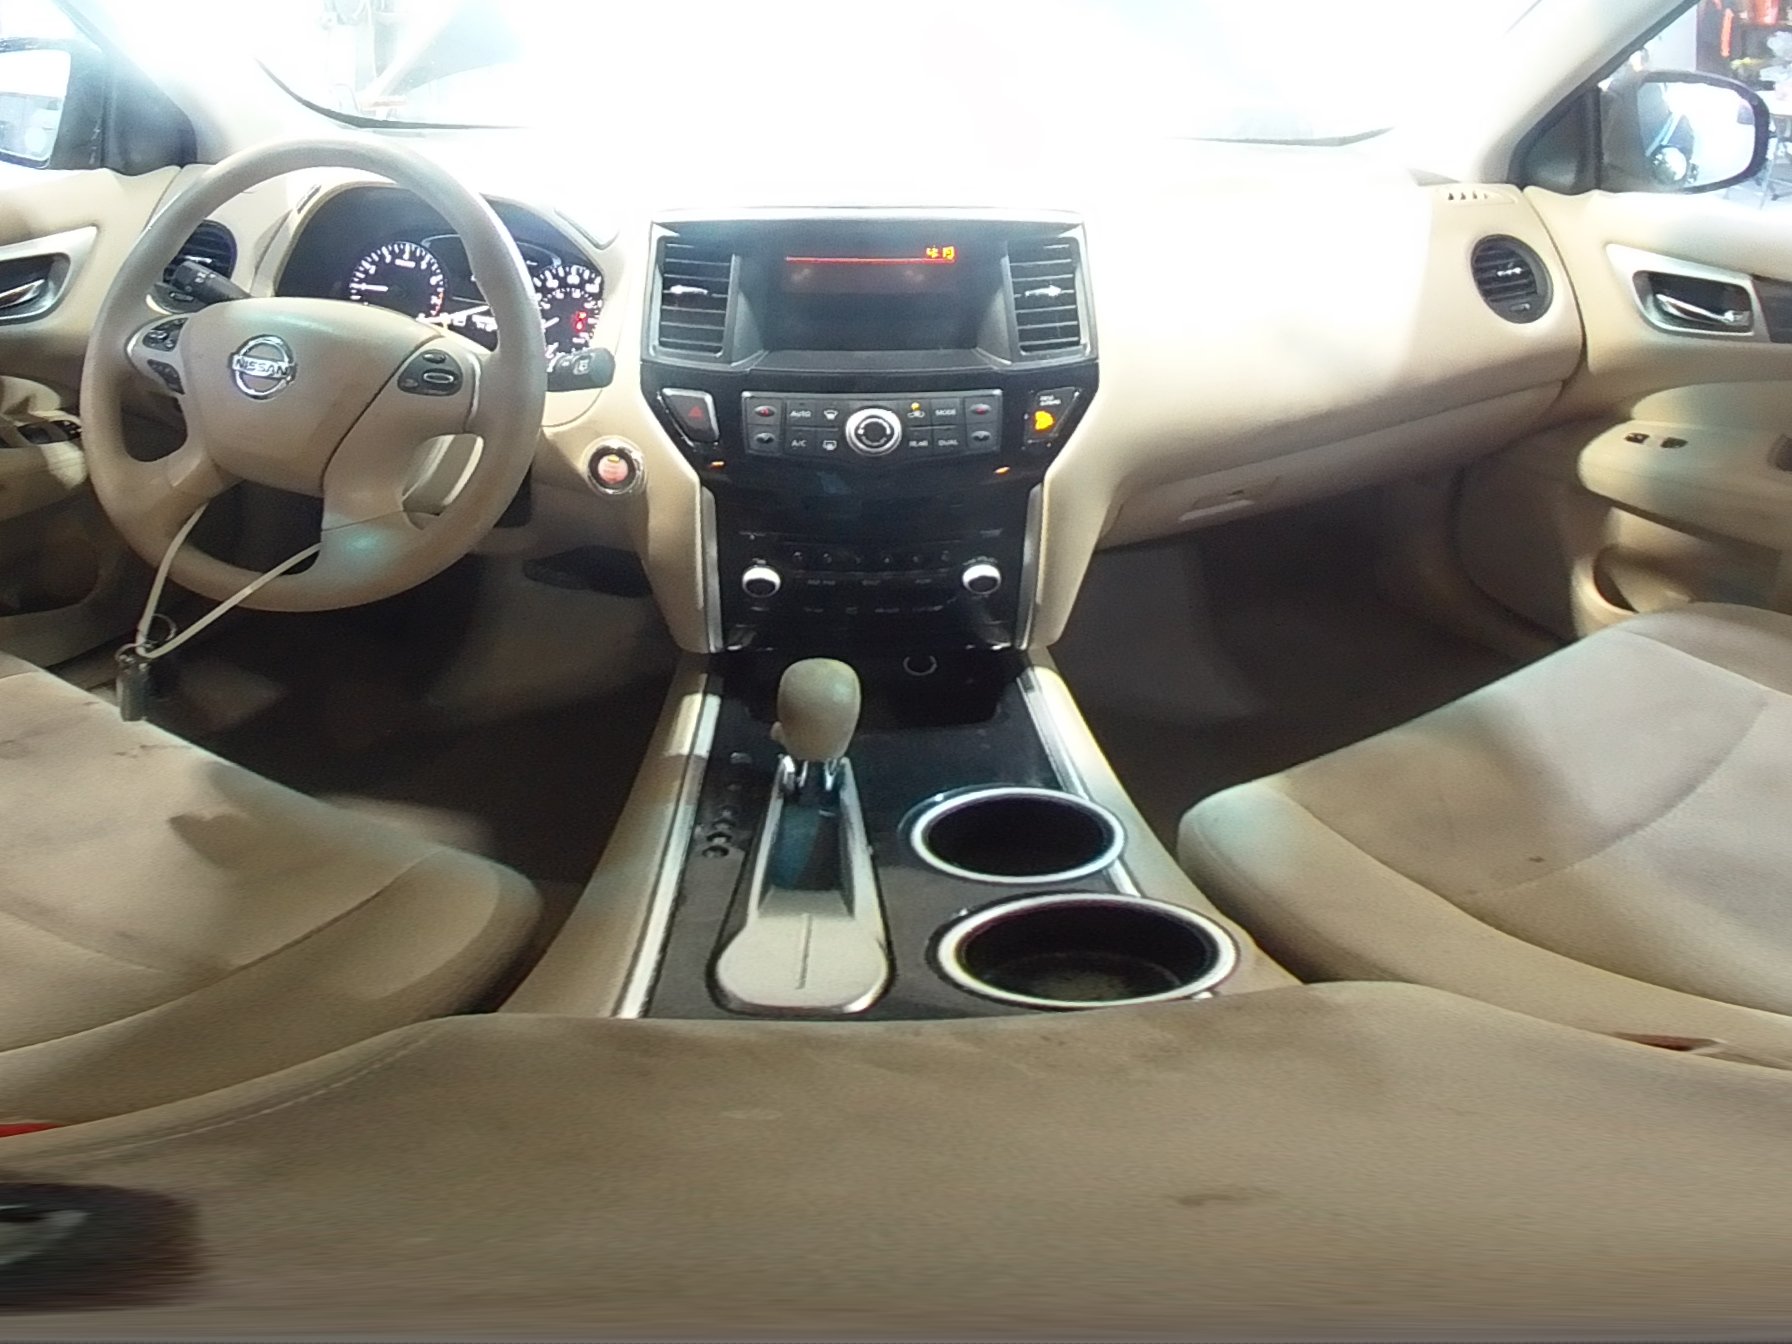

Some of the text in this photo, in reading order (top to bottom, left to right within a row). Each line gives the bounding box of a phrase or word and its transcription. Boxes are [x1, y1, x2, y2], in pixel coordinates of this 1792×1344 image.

[235, 357, 289, 376] NISSAN
[789, 409, 812, 419] AUTO
[934, 408, 957, 418] MODE
[791, 439, 807, 449] A/C
[937, 439, 959, 448] DUAL
